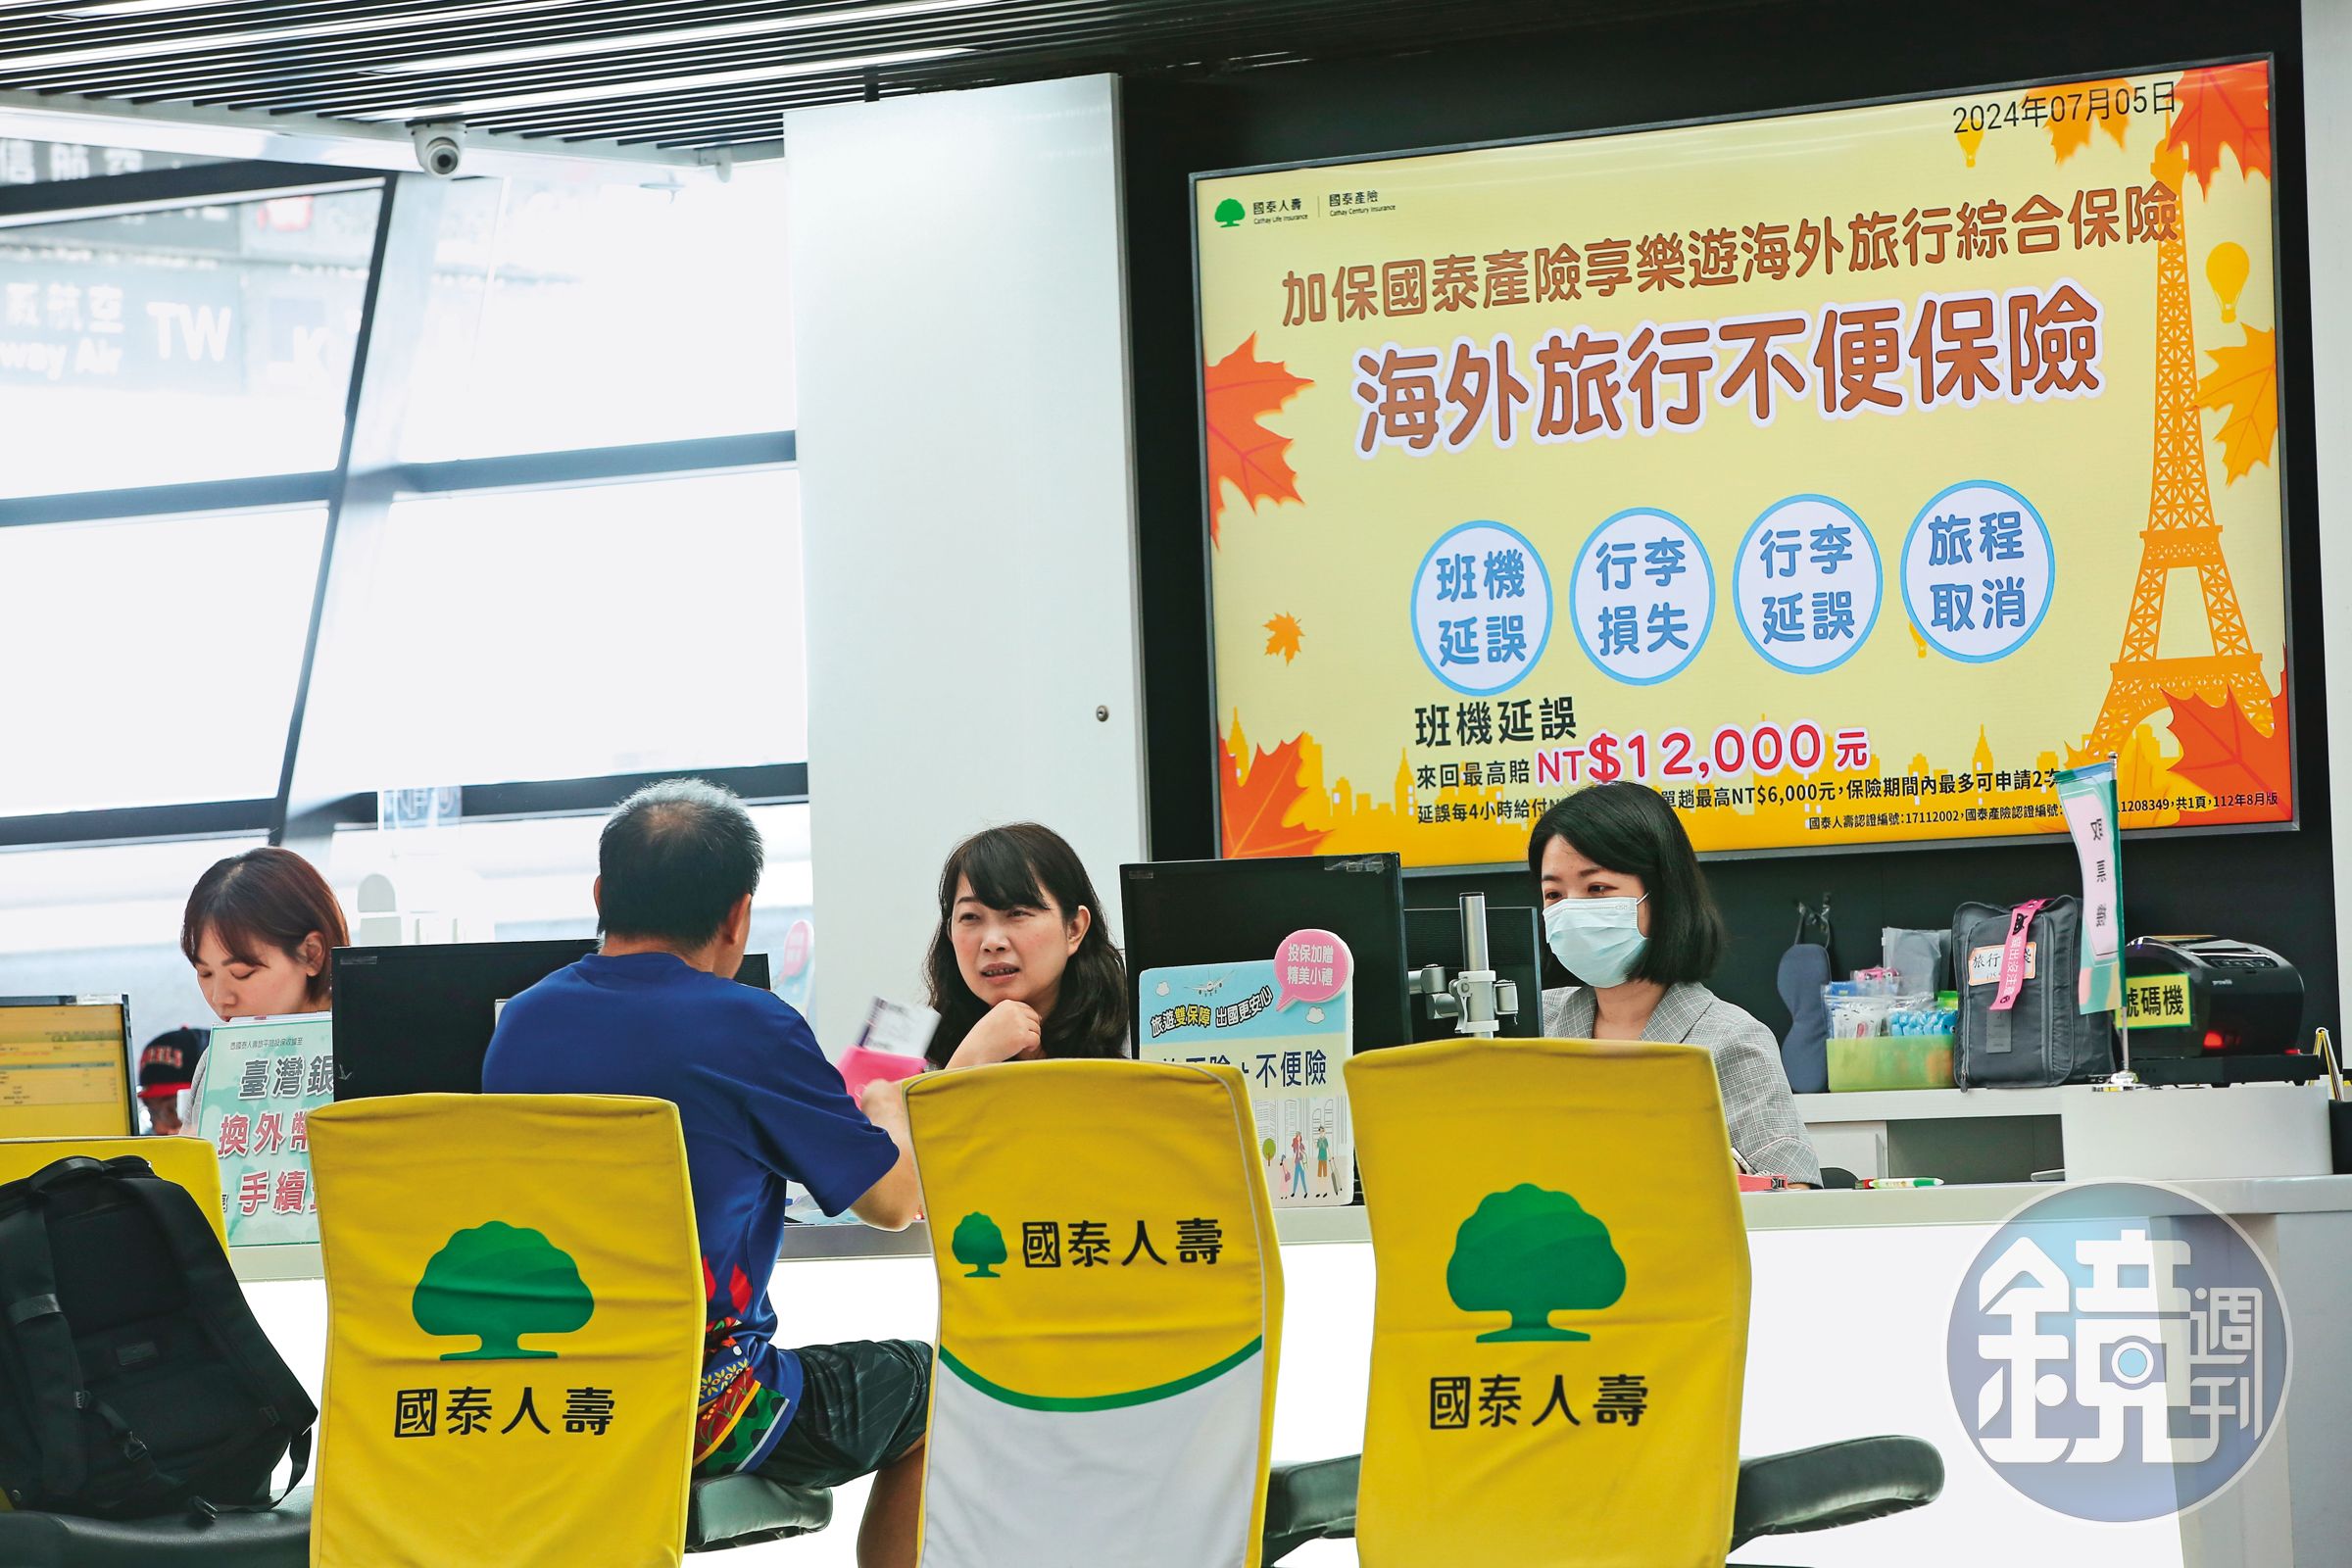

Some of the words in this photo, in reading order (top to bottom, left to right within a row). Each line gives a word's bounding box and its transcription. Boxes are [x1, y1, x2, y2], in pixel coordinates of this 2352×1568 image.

[1952, 80, 2177, 134] 2024年07月05日
[1253, 198, 1302, 215] 國泰人壽
[1329, 190, 1379, 207] 國泰產險
[1282, 181, 2178, 326] 加保國泰產險享樂遊海外旅行綜合保險
[147, 301, 232, 362] TW
[1356, 285, 2100, 453] 海外旅行不便保險
[1595, 536, 1687, 591] 行李
[1759, 523, 1853, 579] 行李
[1928, 511, 2025, 567] 旅程
[1435, 549, 1526, 602] 班機
[1597, 602, 1690, 657] 損失
[1762, 591, 1856, 645] 延誤
[1930, 576, 2027, 632] 取消
[1438, 614, 1527, 667] 延誤
[1414, 696, 1577, 749] 班機延誤
[2118, 792, 2278, 813] 1208349,共1頁,112年8月版
[1287, 965, 1334, 987] 精美小禮
[1288, 943, 1334, 964] 投保加贈
[1151, 1004, 1212, 1038] 旅遊雙保障
[1215, 985, 1274, 1028] 出國更安心
[239, 1055, 333, 1099] 臺灣銀
[1255, 1049, 1327, 1088] 不便險
[218, 1111, 308, 1156] 換外幣
[239, 1170, 318, 1215] 手續
[1021, 1217, 1224, 1269] 國泰人壽
[393, 1386, 616, 1439] 國泰人壽
[1429, 1374, 1649, 1431] 國泰人壽
